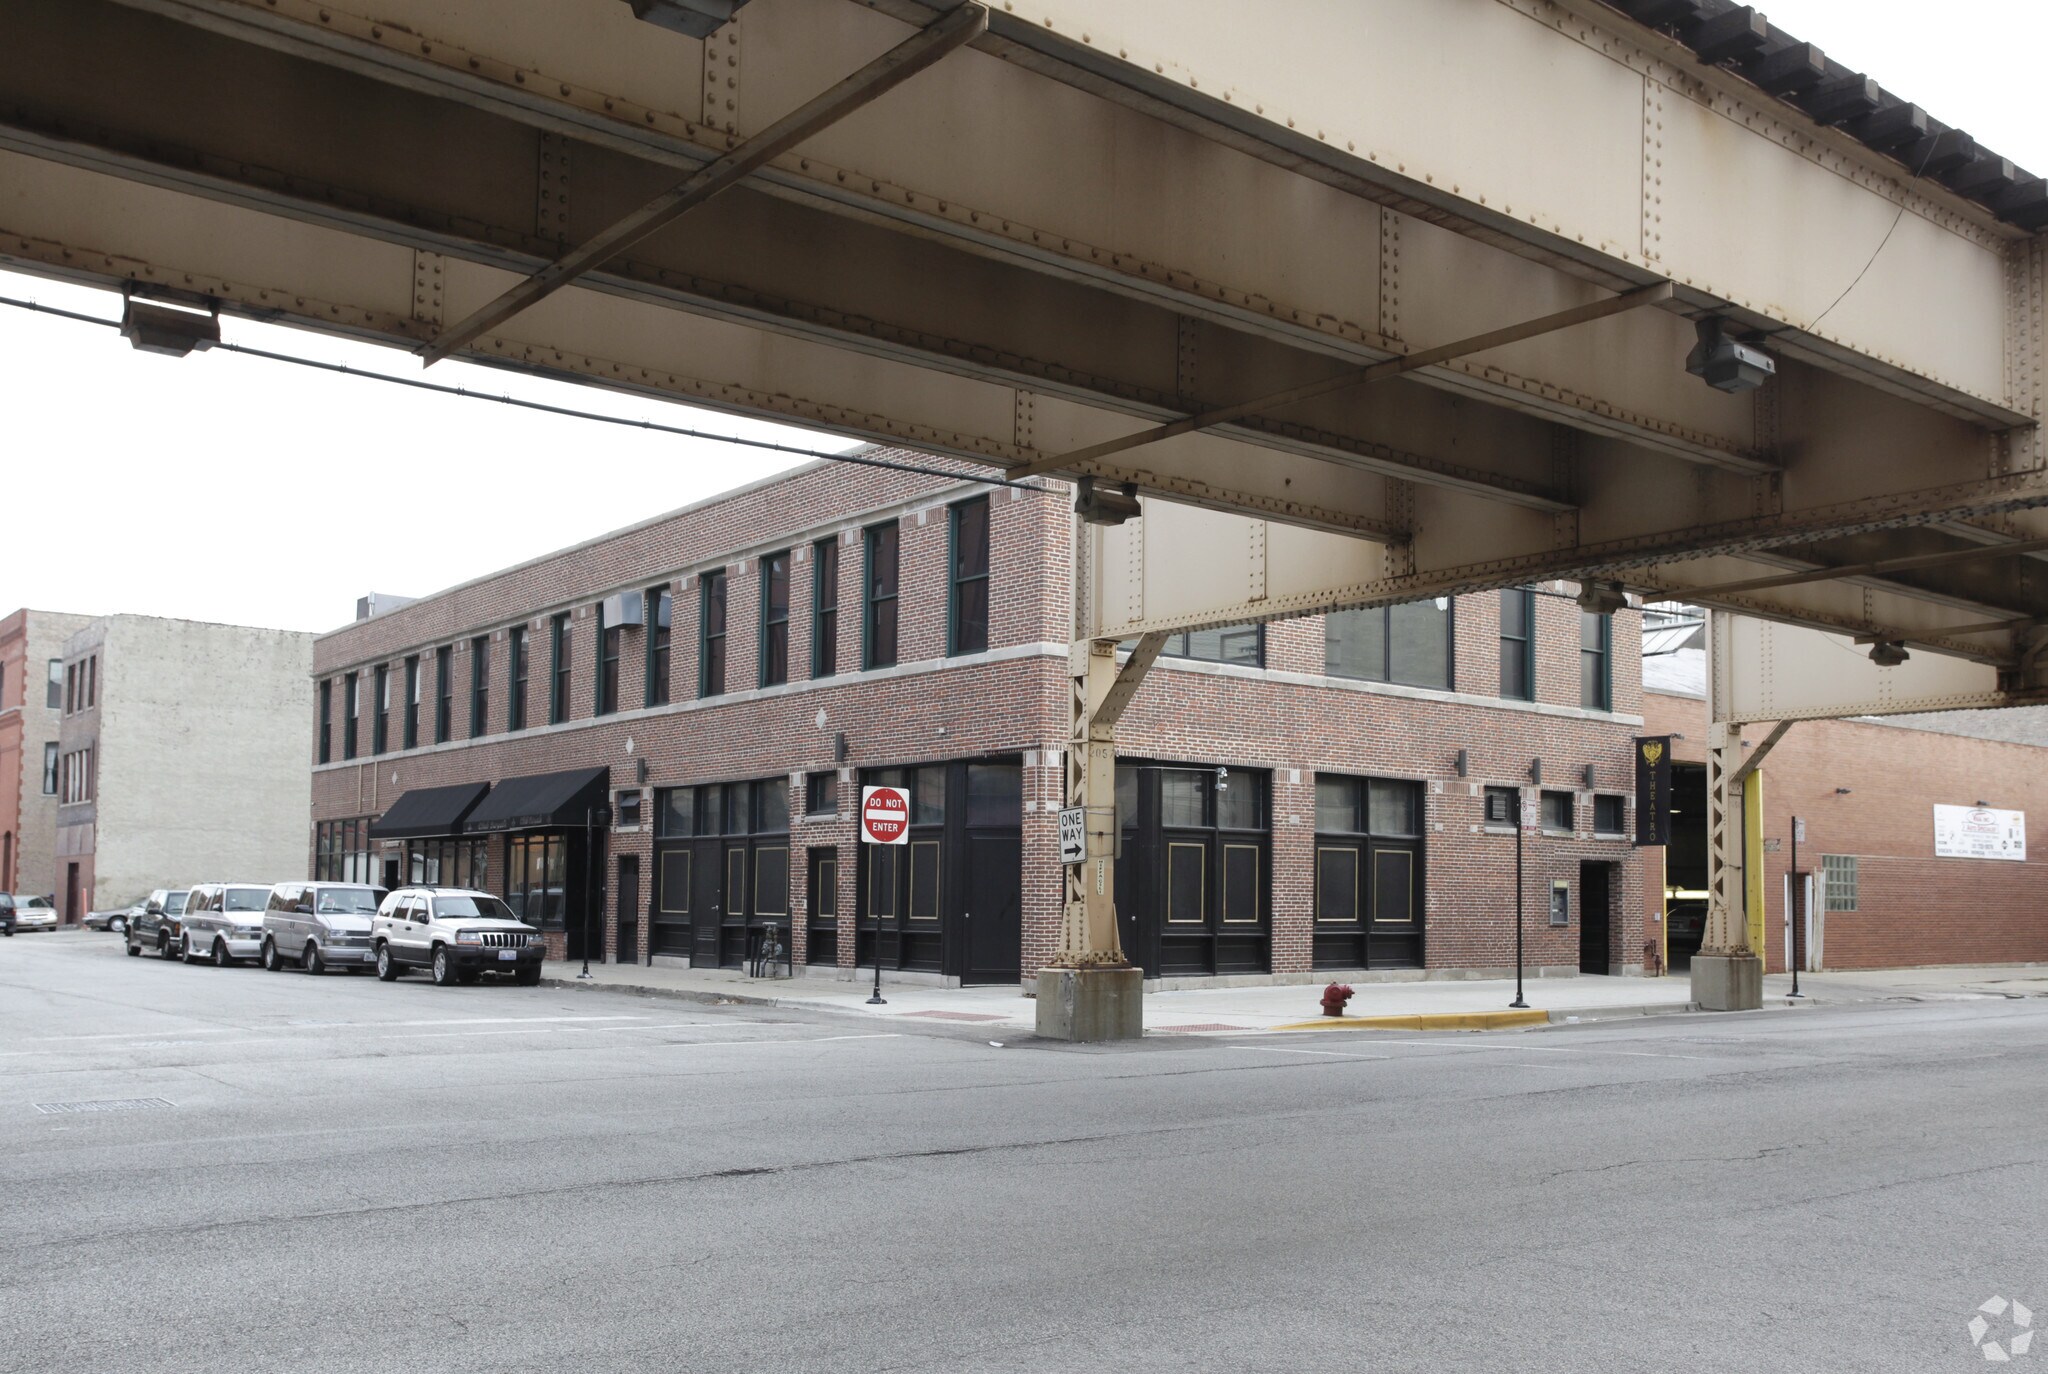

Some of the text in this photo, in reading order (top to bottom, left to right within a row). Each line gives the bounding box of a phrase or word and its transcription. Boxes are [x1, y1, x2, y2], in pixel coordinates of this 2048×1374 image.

[870, 797, 902, 808] DO NOT
[1061, 811, 1081, 827] ONE
[872, 822, 898, 832] ENTER
[1062, 827, 1082, 842] WAY
